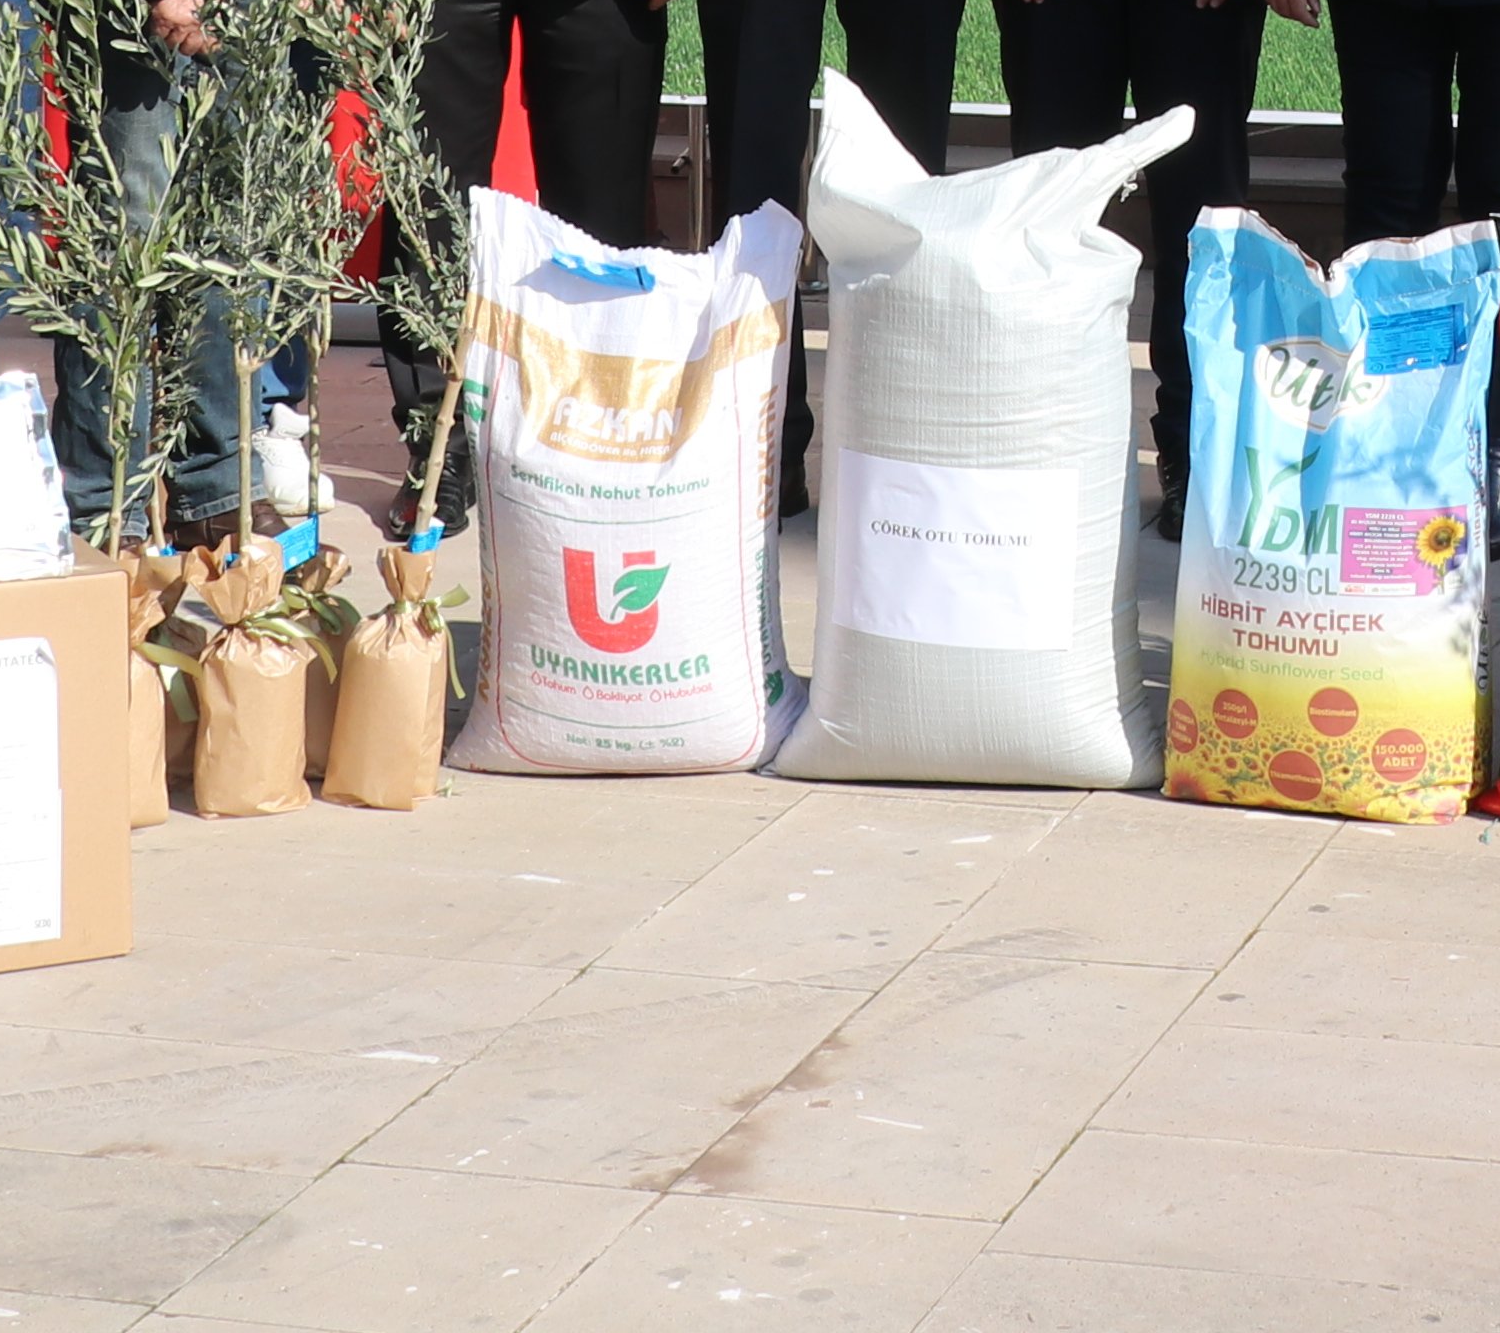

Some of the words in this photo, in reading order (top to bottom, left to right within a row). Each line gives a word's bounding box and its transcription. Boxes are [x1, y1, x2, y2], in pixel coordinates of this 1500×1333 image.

[553, 395, 684, 444] AZKAN
[510, 463, 585, 498] Sertifikalı
[590, 485, 641, 500] Nohut
[646, 476, 710, 499] Tohumu
[1236, 445, 1340, 556] YDM
[870, 519, 921, 541] ÇÖREK
[925, 529, 958, 544] OTU
[964, 531, 1033, 548] TOHUMU
[1233, 557, 1298, 593] 2239
[1306, 567, 1338, 596] CL
[1200, 593, 1267, 625] HİBRİT
[1276, 608, 1385, 635] AYÇİÇEK
[1232, 628, 1339, 657] TOHUMU
[531, 644, 712, 686] UYANIKERLER
[1200, 649, 1245, 671] Hybrid
[1249, 658, 1335, 680] Sunflower
[1340, 666, 1384, 681] Seed
[541, 675, 577, 695] Tohum
[595, 689, 644, 704] Bakliyat
[663, 682, 714, 701] Hububat
[1375, 743, 1424, 755] 150.000
[1382, 756, 1417, 768] ADET
